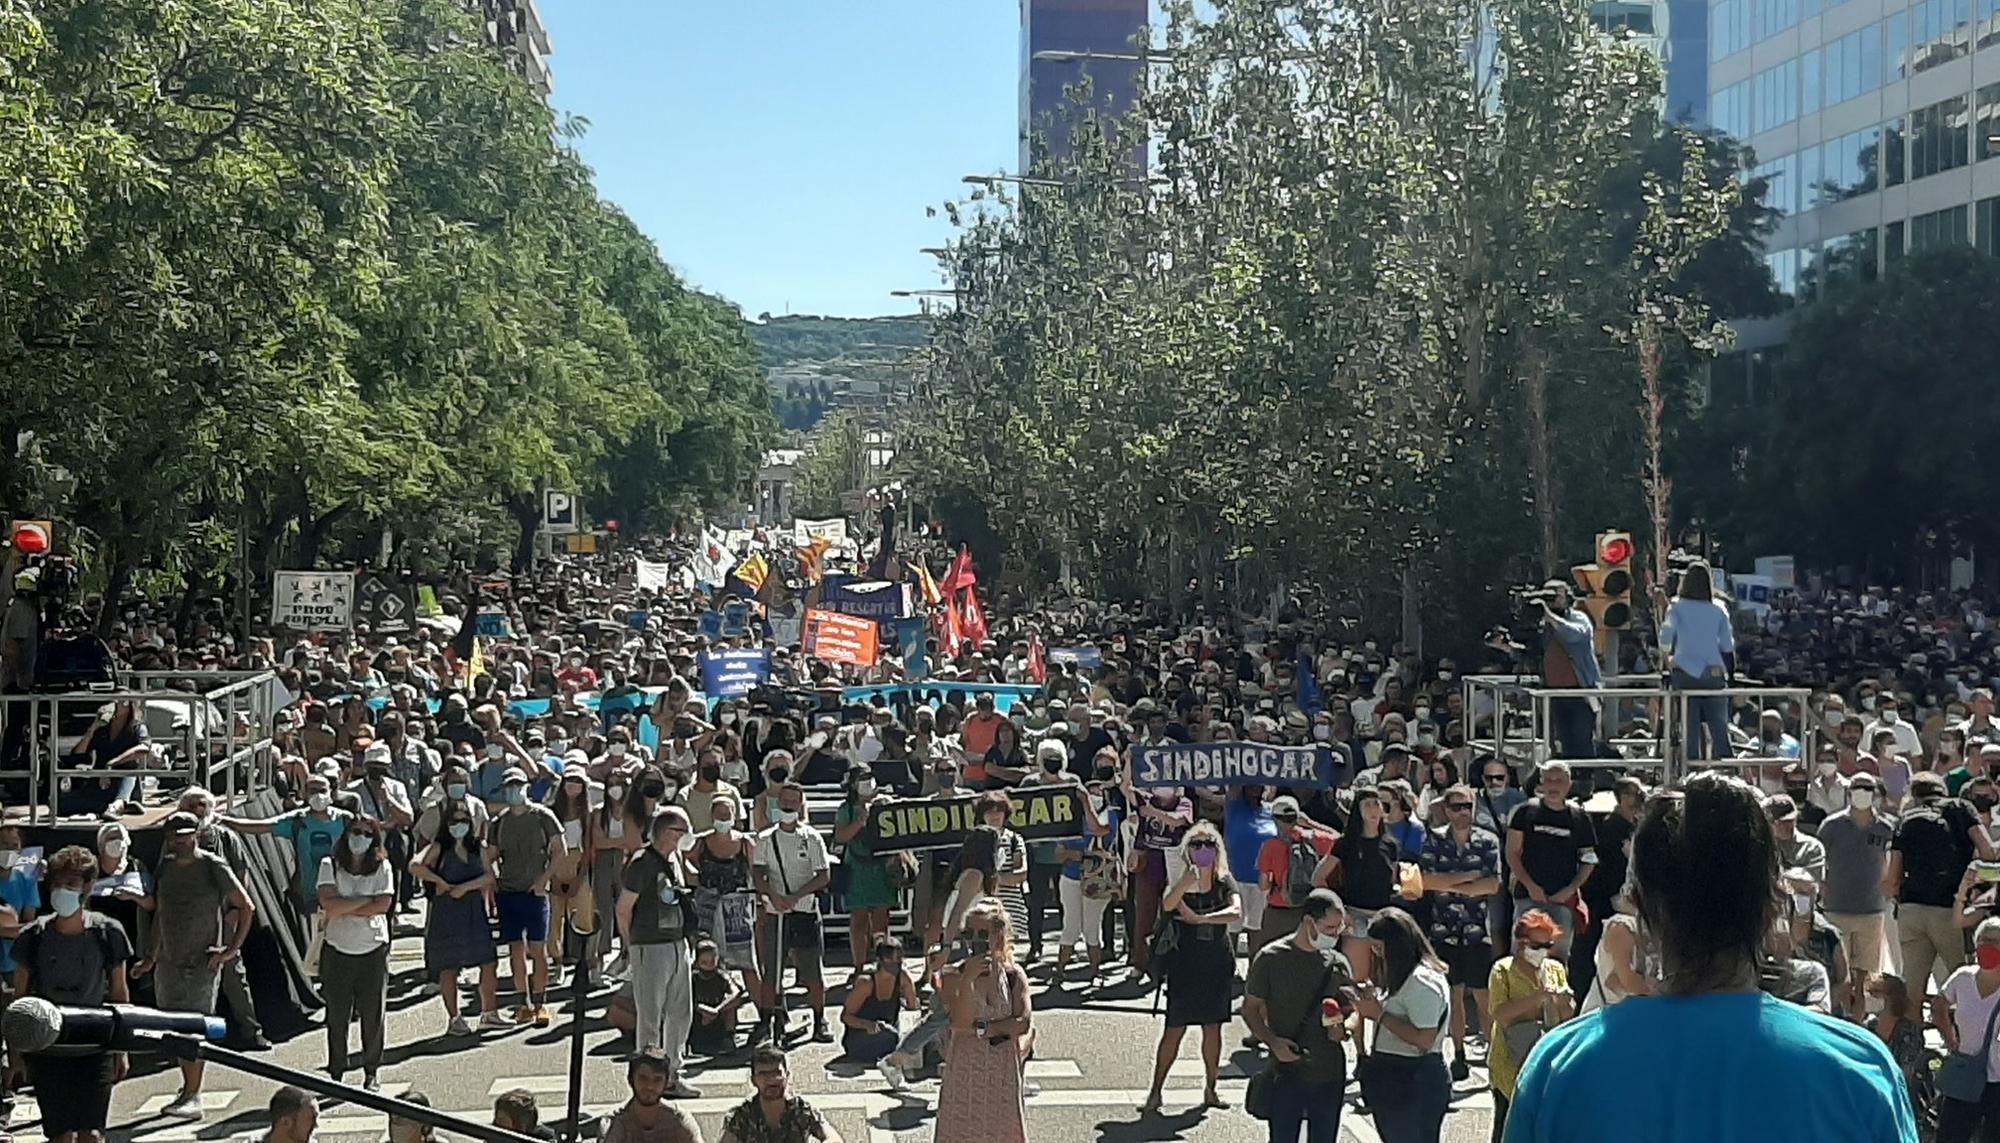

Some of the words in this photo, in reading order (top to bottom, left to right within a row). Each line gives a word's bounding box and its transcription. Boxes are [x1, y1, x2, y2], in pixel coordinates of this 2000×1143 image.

[550, 493, 569, 518] P
[1140, 748, 1317, 782] SINDIHOGAR
[878, 795, 1073, 838] SINDIGAR
